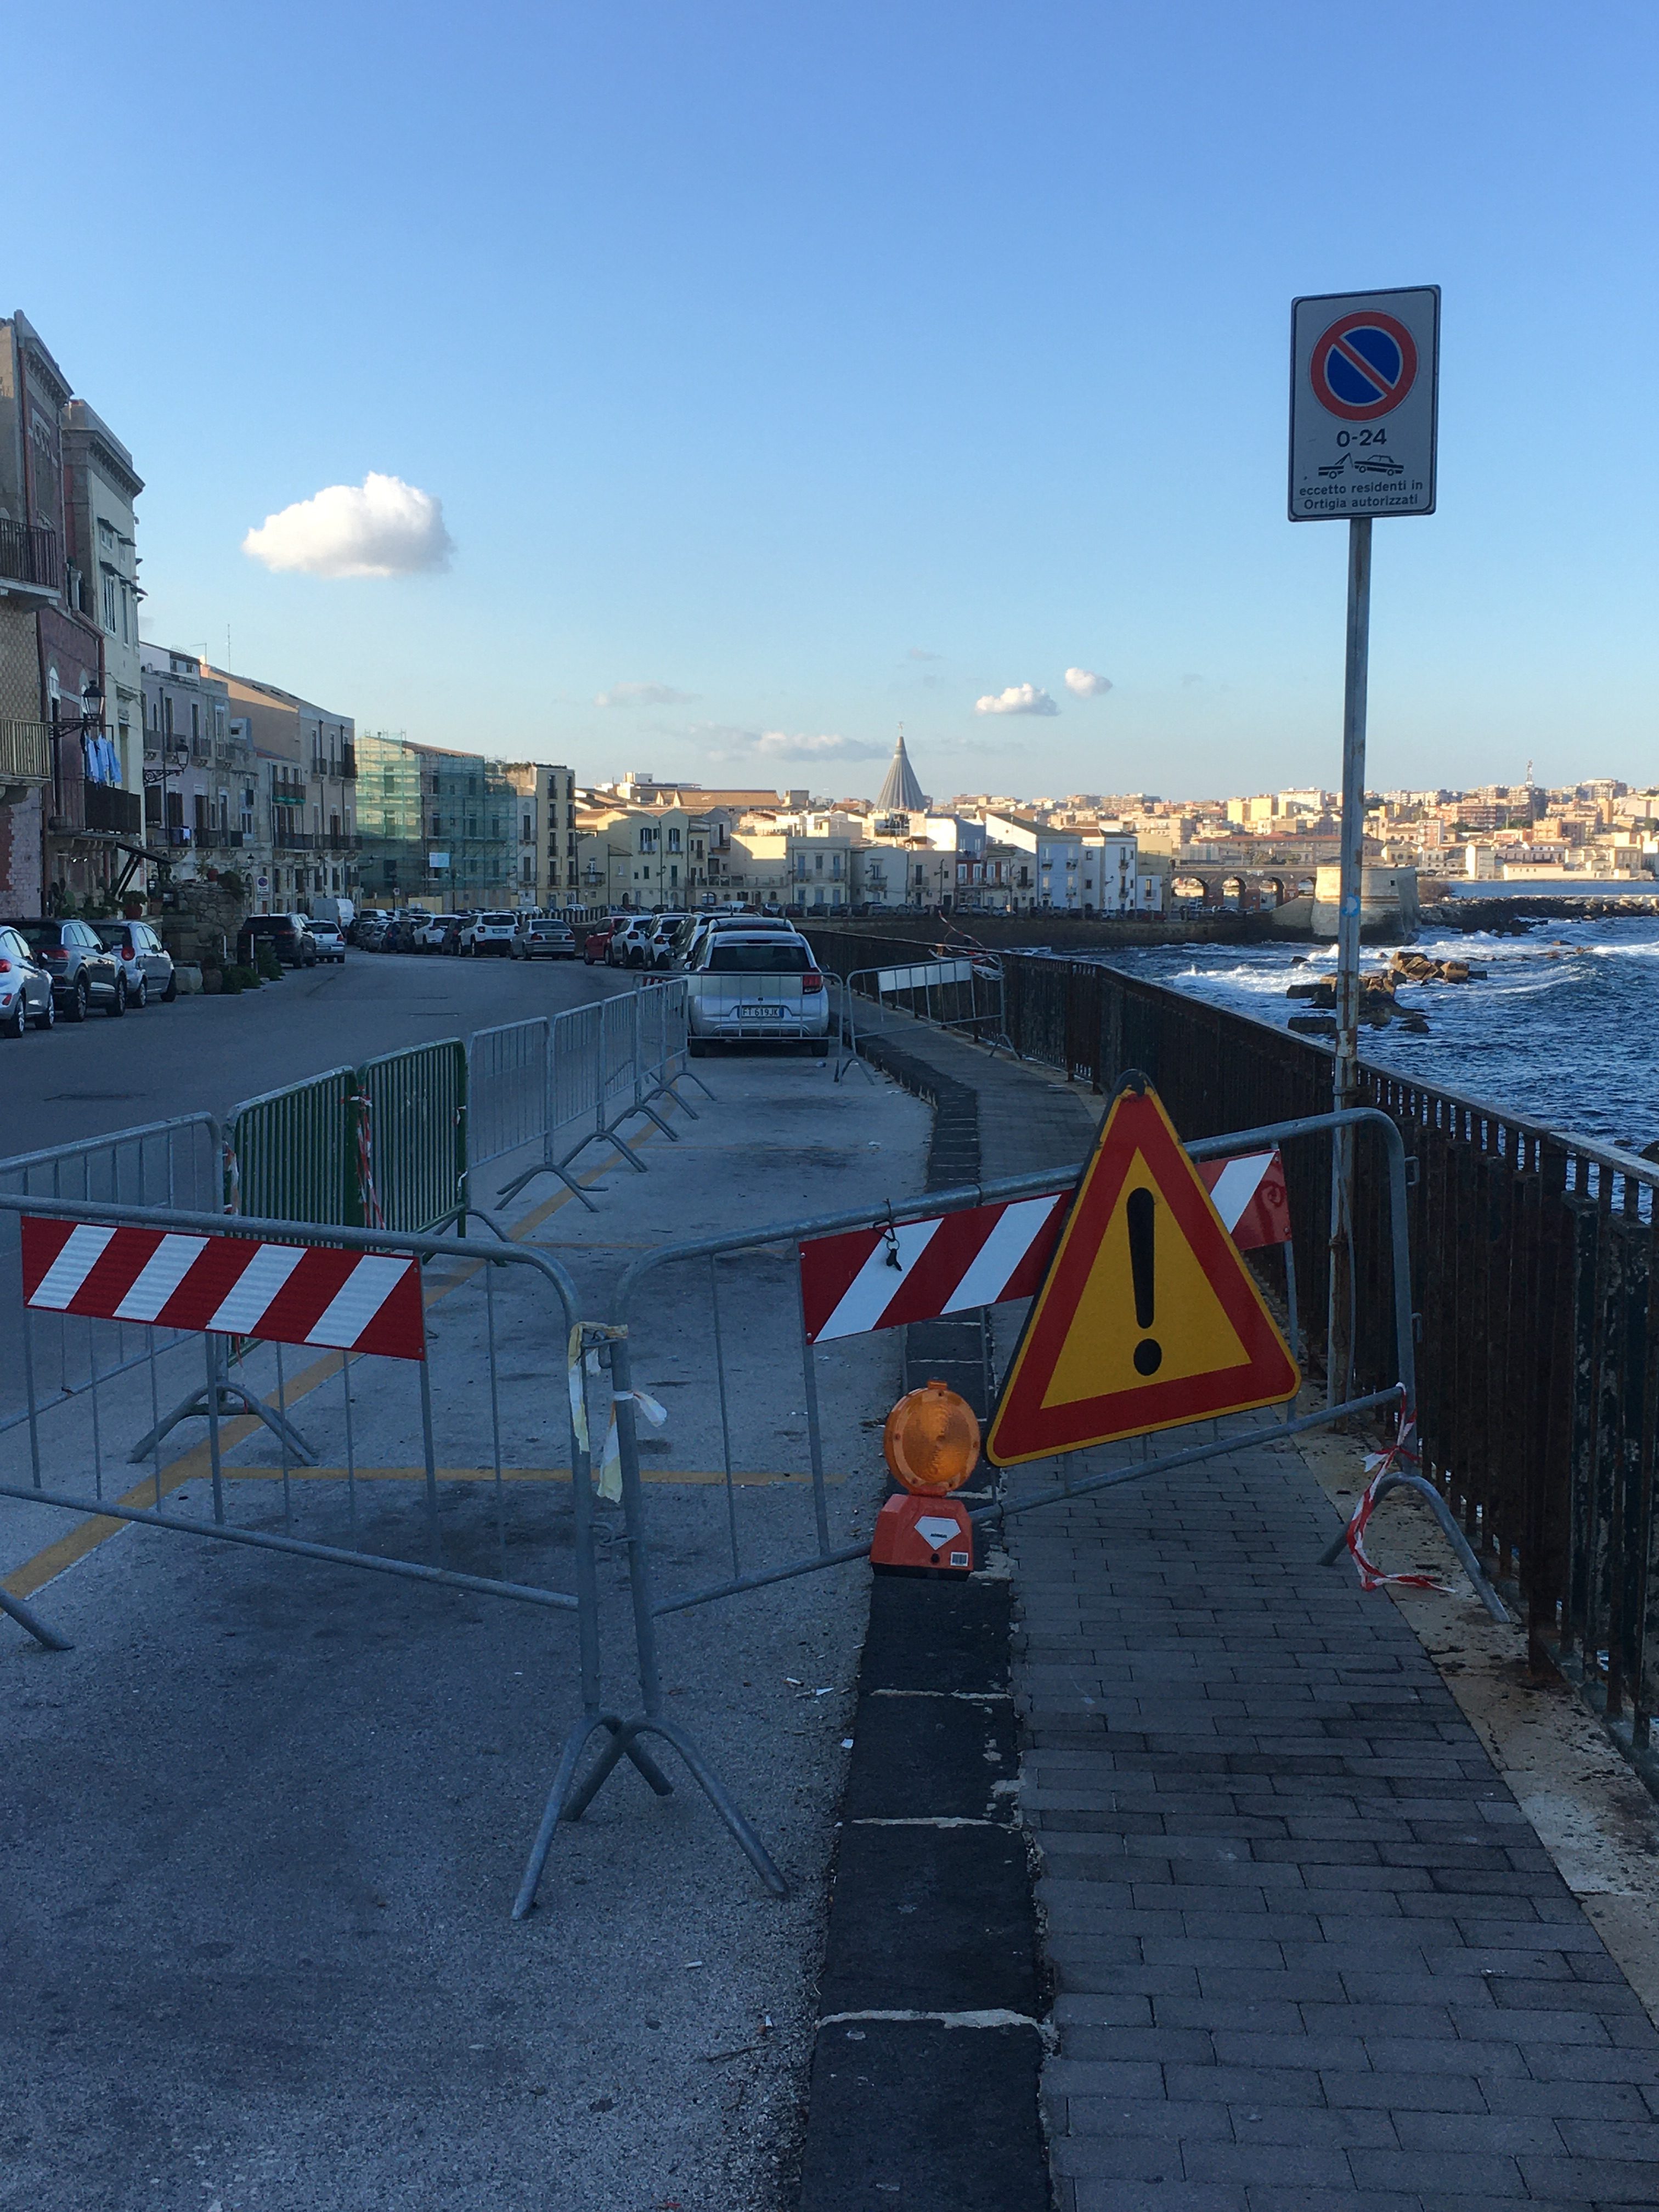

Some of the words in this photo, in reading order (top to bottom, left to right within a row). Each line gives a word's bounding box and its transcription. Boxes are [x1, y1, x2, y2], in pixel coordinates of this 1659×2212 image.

[1337, 428, 1387, 447] 0-24
[1300, 484, 1346, 495] eccetto
[1351, 480, 1406, 493] residenti
[1412, 479, 1423, 490] in
[1304, 498, 1347, 510] Ortigia
[1352, 494, 1418, 507] autorizzati
